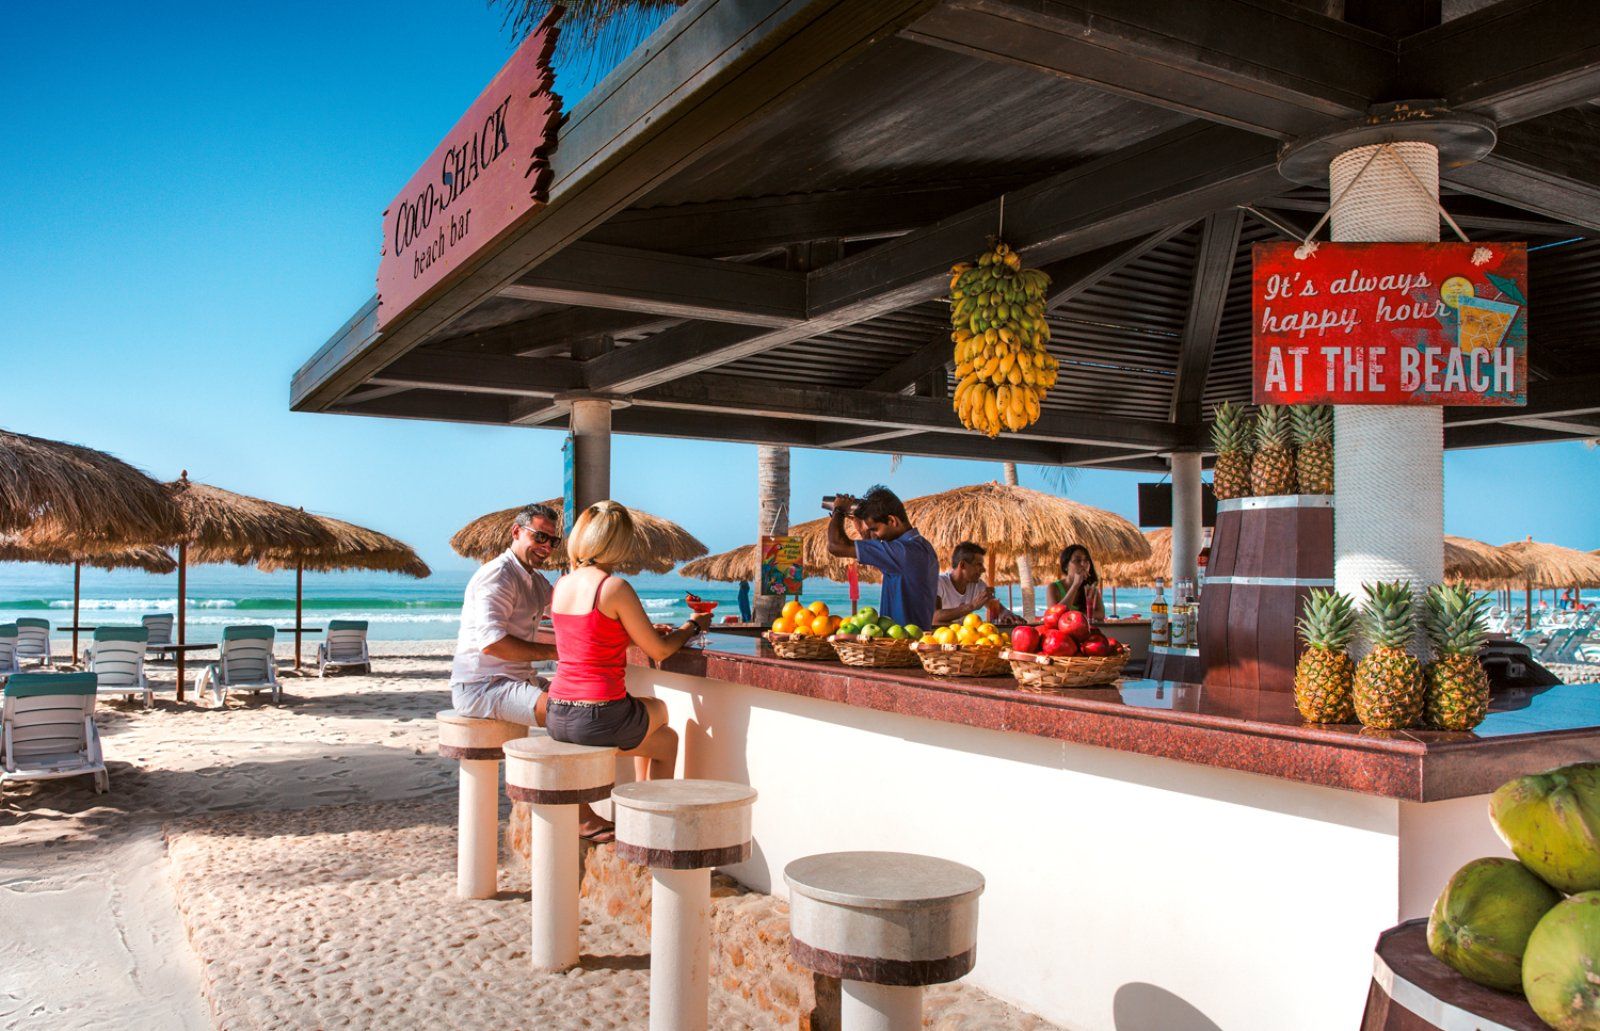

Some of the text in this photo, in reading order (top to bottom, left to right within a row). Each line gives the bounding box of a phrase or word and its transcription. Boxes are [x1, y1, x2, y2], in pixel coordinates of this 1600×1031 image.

[414, 207, 472, 279] beach bar
[1264, 270, 1432, 300] It's always
[1262, 297, 1451, 338] happy hour
[1264, 347, 1514, 392] AT THE BEACH
